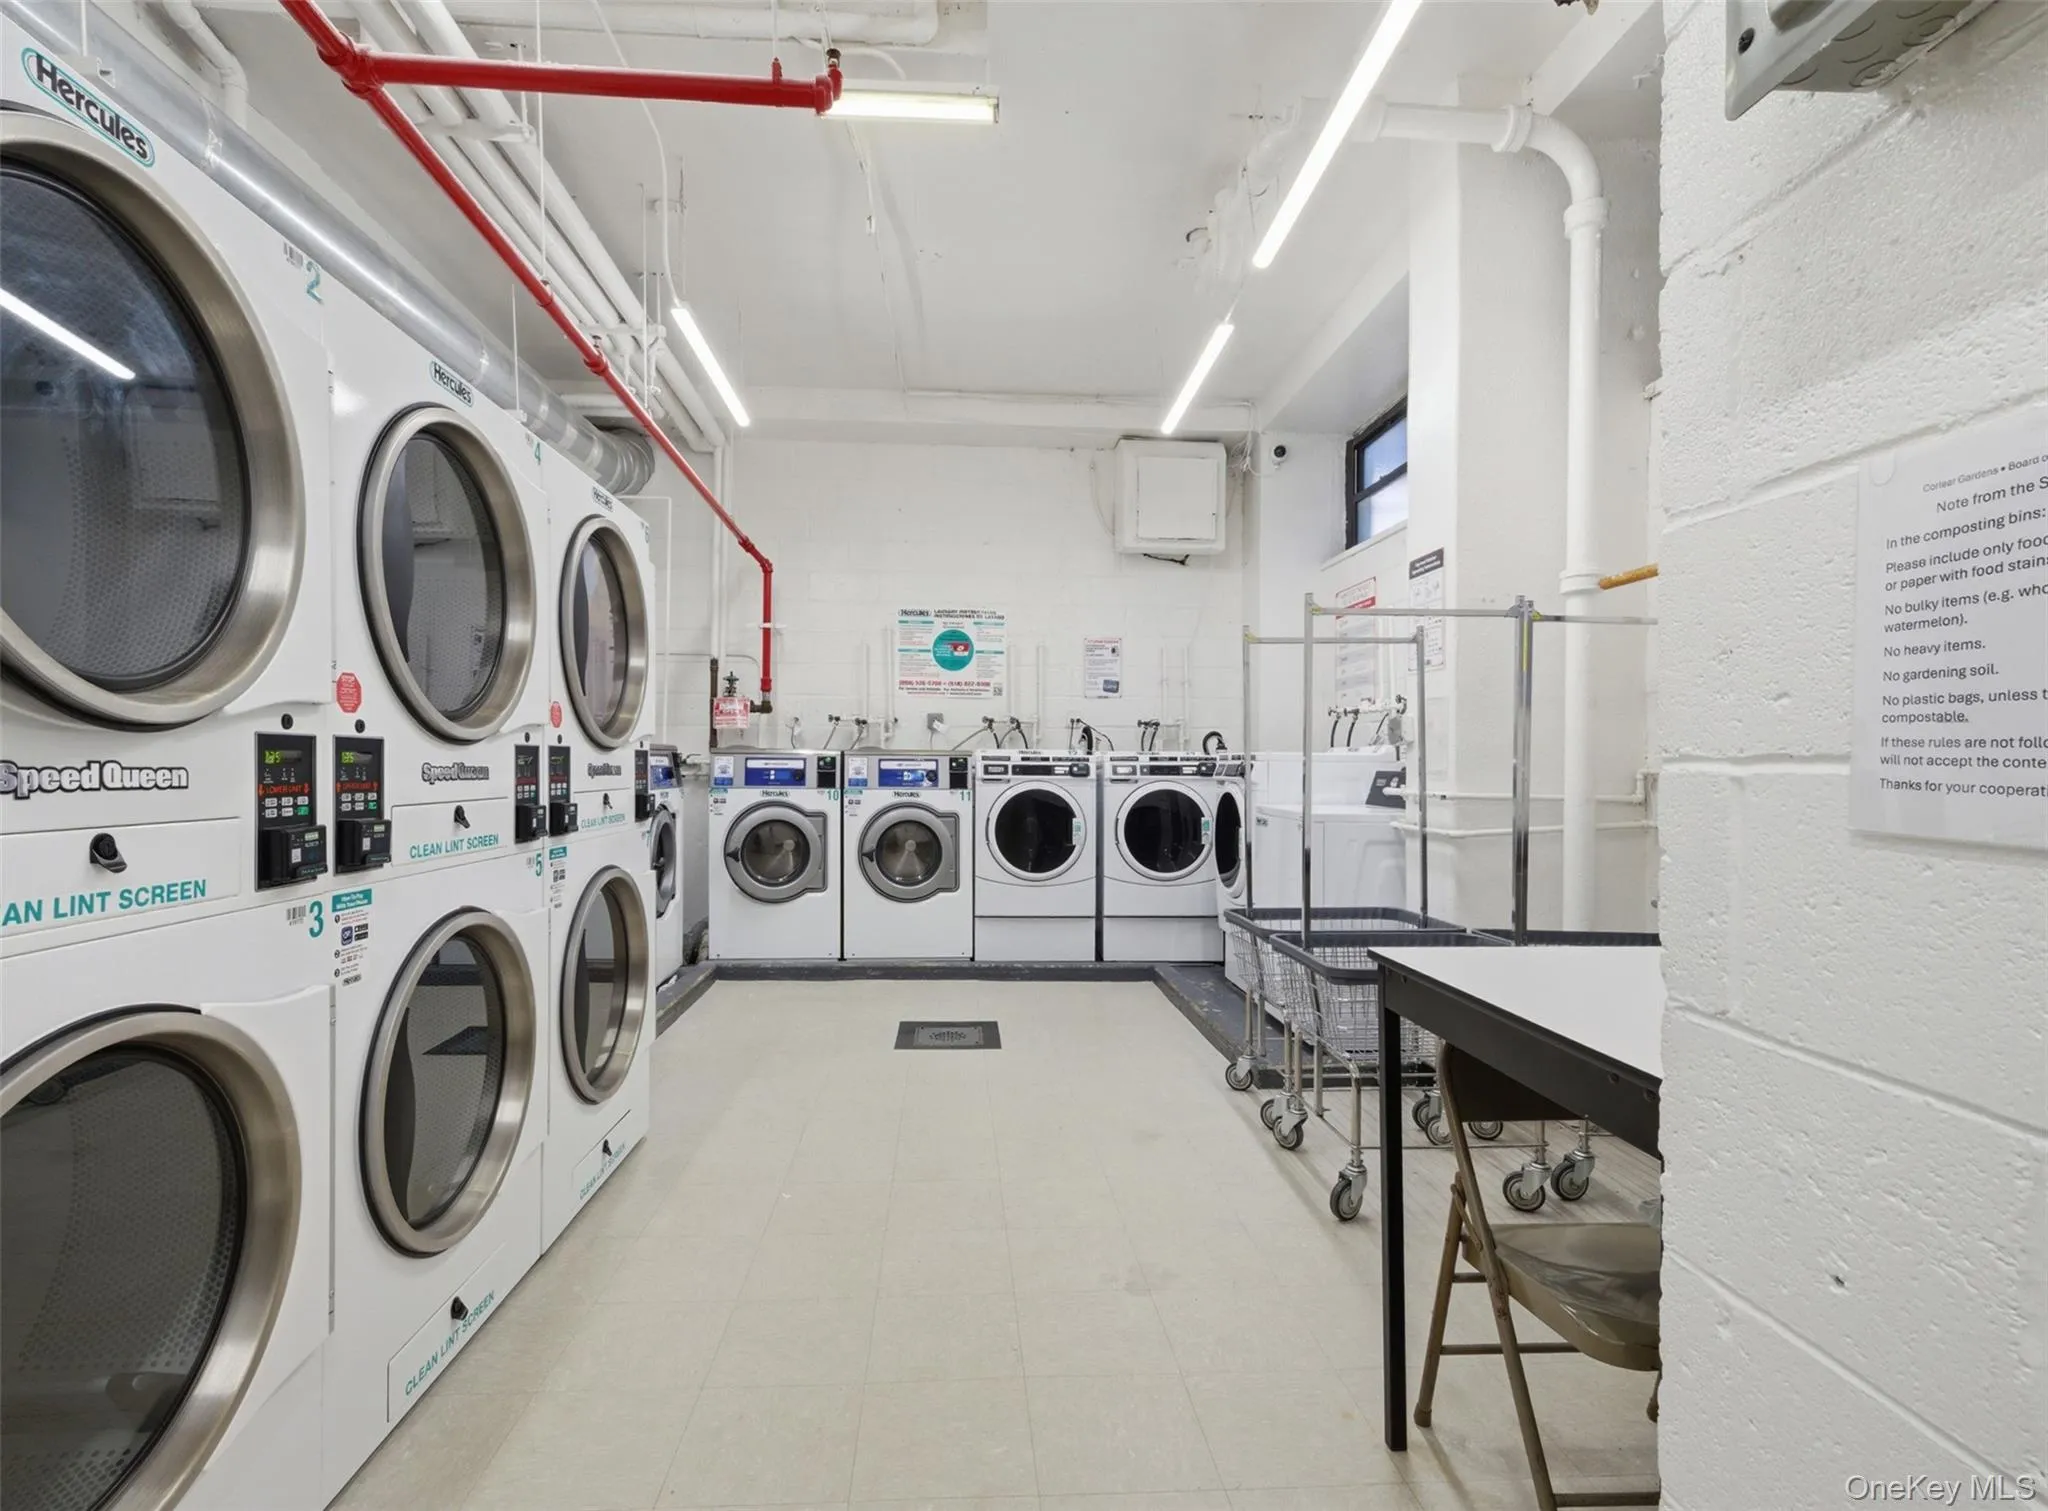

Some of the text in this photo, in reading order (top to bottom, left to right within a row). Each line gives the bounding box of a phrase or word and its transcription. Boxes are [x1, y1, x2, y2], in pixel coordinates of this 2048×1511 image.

[35, 52, 149, 160] Hercules
[306, 260, 323, 304] 2
[432, 363, 472, 404] Hercules
[534, 441, 541, 465] 4
[1923, 478, 1956, 493] Corlear
[1958, 466, 1999, 484] Gardens
[2008, 456, 2040, 471] Board
[1936, 498, 1969, 513] Note
[1973, 487, 2006, 505] from
[2010, 482, 2035, 496] the
[1886, 508, 2046, 549] In the composting bins:
[1886, 557, 1926, 573] Please
[1929, 548, 1980, 566] include
[1983, 542, 2014, 557] only
[1885, 556, 2048, 591] or paper with food stain
[1885, 605, 1902, 616] No
[1905, 597, 1938, 614] bulky
[1941, 593, 1979, 609] items
[1983, 589, 2014, 605] (e.g.
[1884, 613, 1968, 633] watermelon).
[1884, 639, 1986, 657] No heavy items.
[1883, 664, 1999, 683] No gardening soil.
[1882, 696, 1899, 706] No
[1902, 693, 1945, 707] plastic
[1949, 692, 1984, 705] bags,
[1988, 689, 2038, 702] unless
[1882, 711, 1969, 724] compostable.
[1881, 737, 1889, 748] If
[1892, 737, 1925, 748] these
[1928, 737, 1961, 748] rules
[1964, 739, 1987, 748] are
[1990, 738, 2014, 749] not
[1880, 755, 1900, 765] will
[1904, 756, 1923, 766] not
[1927, 757, 1973, 768] accept
[1977, 757, 1999, 767] the
[827, 789, 840, 801] 10
[960, 790, 972, 801] 11
[1880, 778, 1922, 790] Thanks
[1925, 781, 1943, 791] for
[1945, 783, 1975, 794] your
[410, 834, 499, 858] CLEAN LINT SCREEN
[536, 853, 543, 877] 5
[53, 891, 111, 919] LINT
[118, 879, 206, 910] SCREEN
[309, 900, 323, 937] 3
[405, 1290, 495, 1396] CLEAN LINT SCREEN
